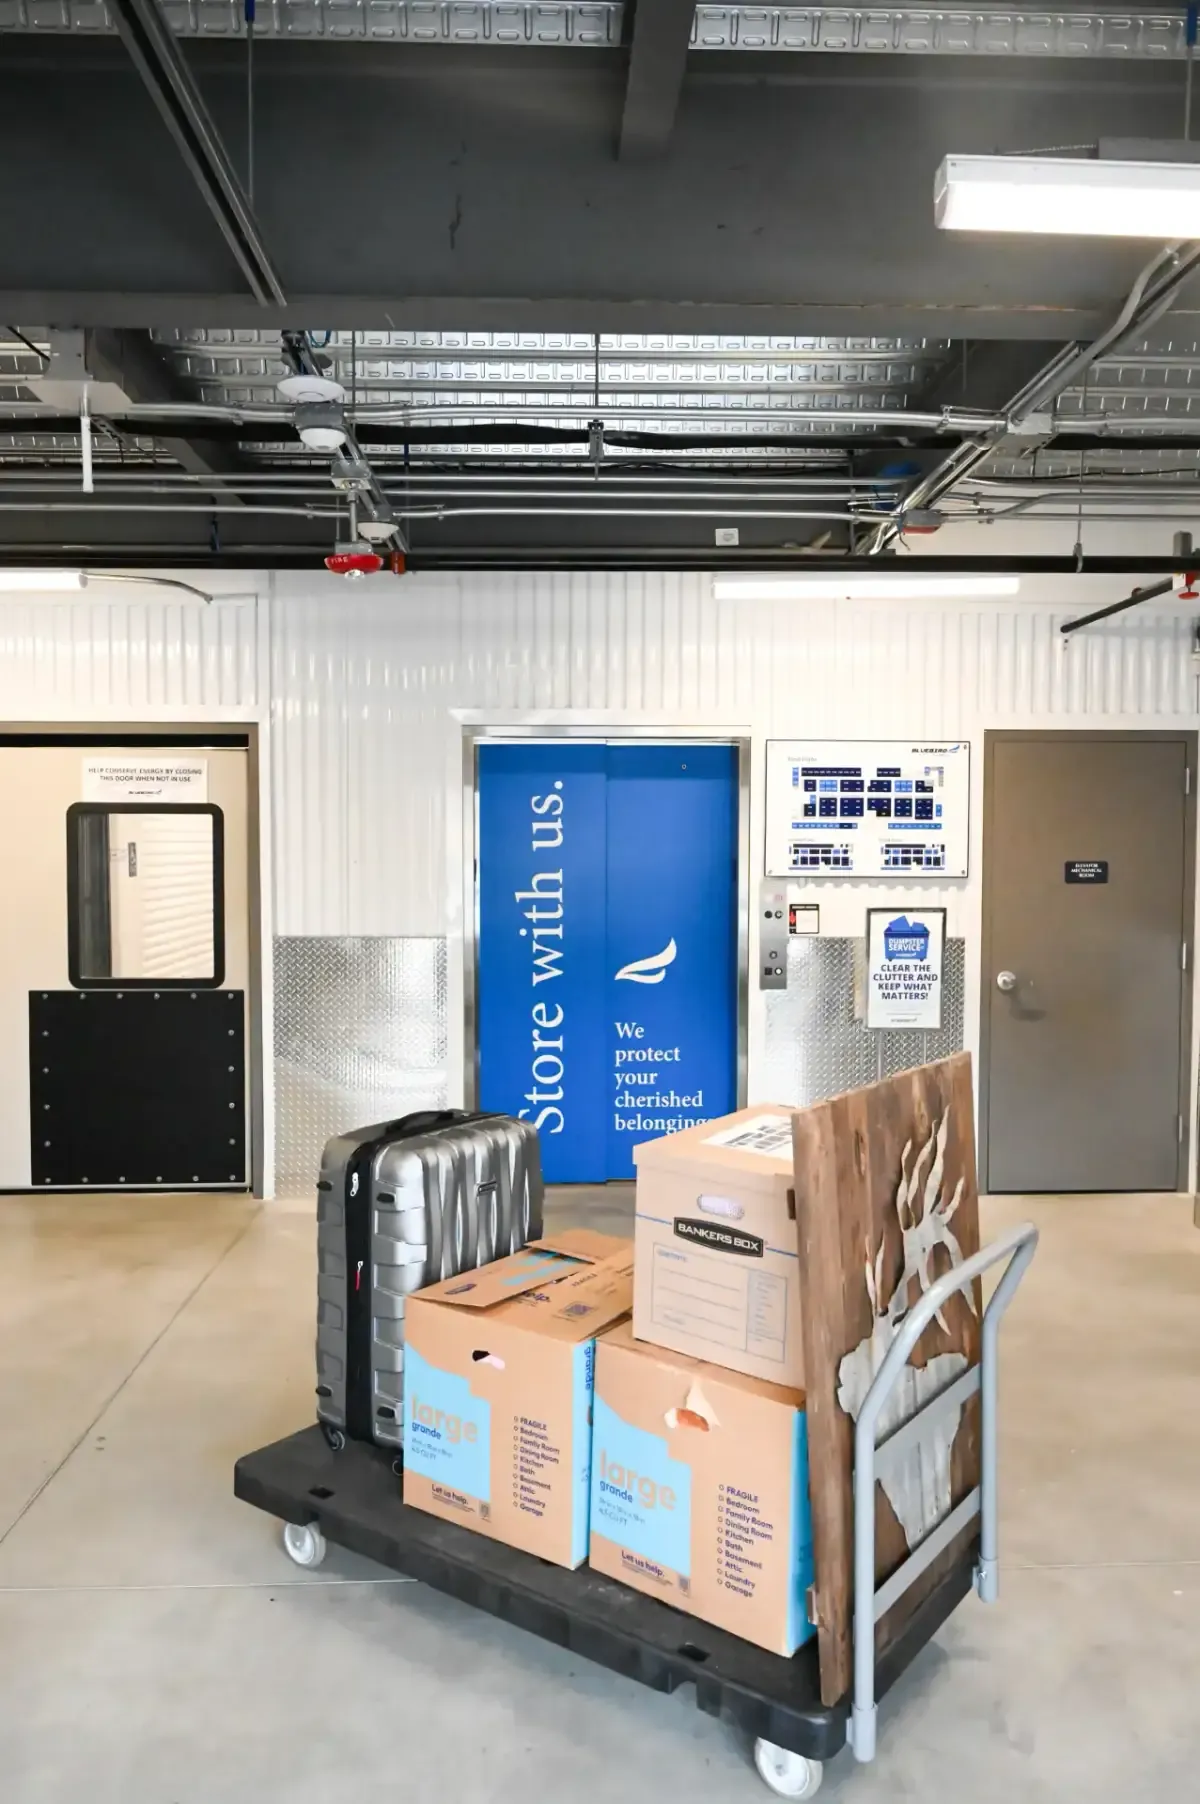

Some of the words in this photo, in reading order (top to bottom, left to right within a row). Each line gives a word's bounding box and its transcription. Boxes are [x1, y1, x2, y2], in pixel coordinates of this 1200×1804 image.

[531, 780, 565, 851] us.
[514, 869, 565, 987] with
[888, 944, 921, 952] SERVICE
[880, 964, 910, 972] CLEAR
[913, 964, 932, 972] THE
[873, 974, 914, 982] CLUTTER
[916, 974, 938, 982] AND
[878, 982, 901, 990] KEEP
[904, 982, 933, 991] WHAT
[882, 992, 928, 1000] MATTERS!
[614, 1022, 645, 1039] We
[614, 1047, 682, 1068] protect
[518, 1002, 565, 1134] Store
[614, 1072, 658, 1090] your
[614, 1090, 704, 1108] cherished
[614, 1113, 713, 1136] belongin
[678, 1223, 732, 1244] BANKERS
[734, 1236, 760, 1252] BOX
[411, 1394, 478, 1445] large
[520, 1417, 547, 1431] FRAGILE
[412, 1422, 442, 1440] grande
[520, 1427, 548, 1440] Bedroom
[520, 1436, 540, 1449] Family
[542, 1443, 560, 1454] Room
[520, 1456, 544, 1468] Kitchen
[541, 1452, 560, 1464] Room
[600, 1447, 677, 1511] large
[432, 1484, 442, 1492] Let
[444, 1490, 452, 1498] us
[600, 1480, 633, 1504] grande
[726, 1486, 758, 1503] FRAGILE
[726, 1496, 760, 1514] Bedroom
[726, 1508, 750, 1523] Family
[752, 1517, 774, 1530] Room
[725, 1518, 750, 1534] Dining
[750, 1528, 772, 1540] Room
[726, 1529, 754, 1546] Kitchen
[725, 1540, 743, 1552] Bath
[622, 1550, 634, 1562] Let
[635, 1558, 644, 1568] us
[645, 1560, 665, 1577] help.
[724, 1550, 762, 1569] Basement
[724, 1560, 743, 1572] Attic
[724, 1571, 756, 1589] Laundry
[724, 1580, 753, 1598] Garage
